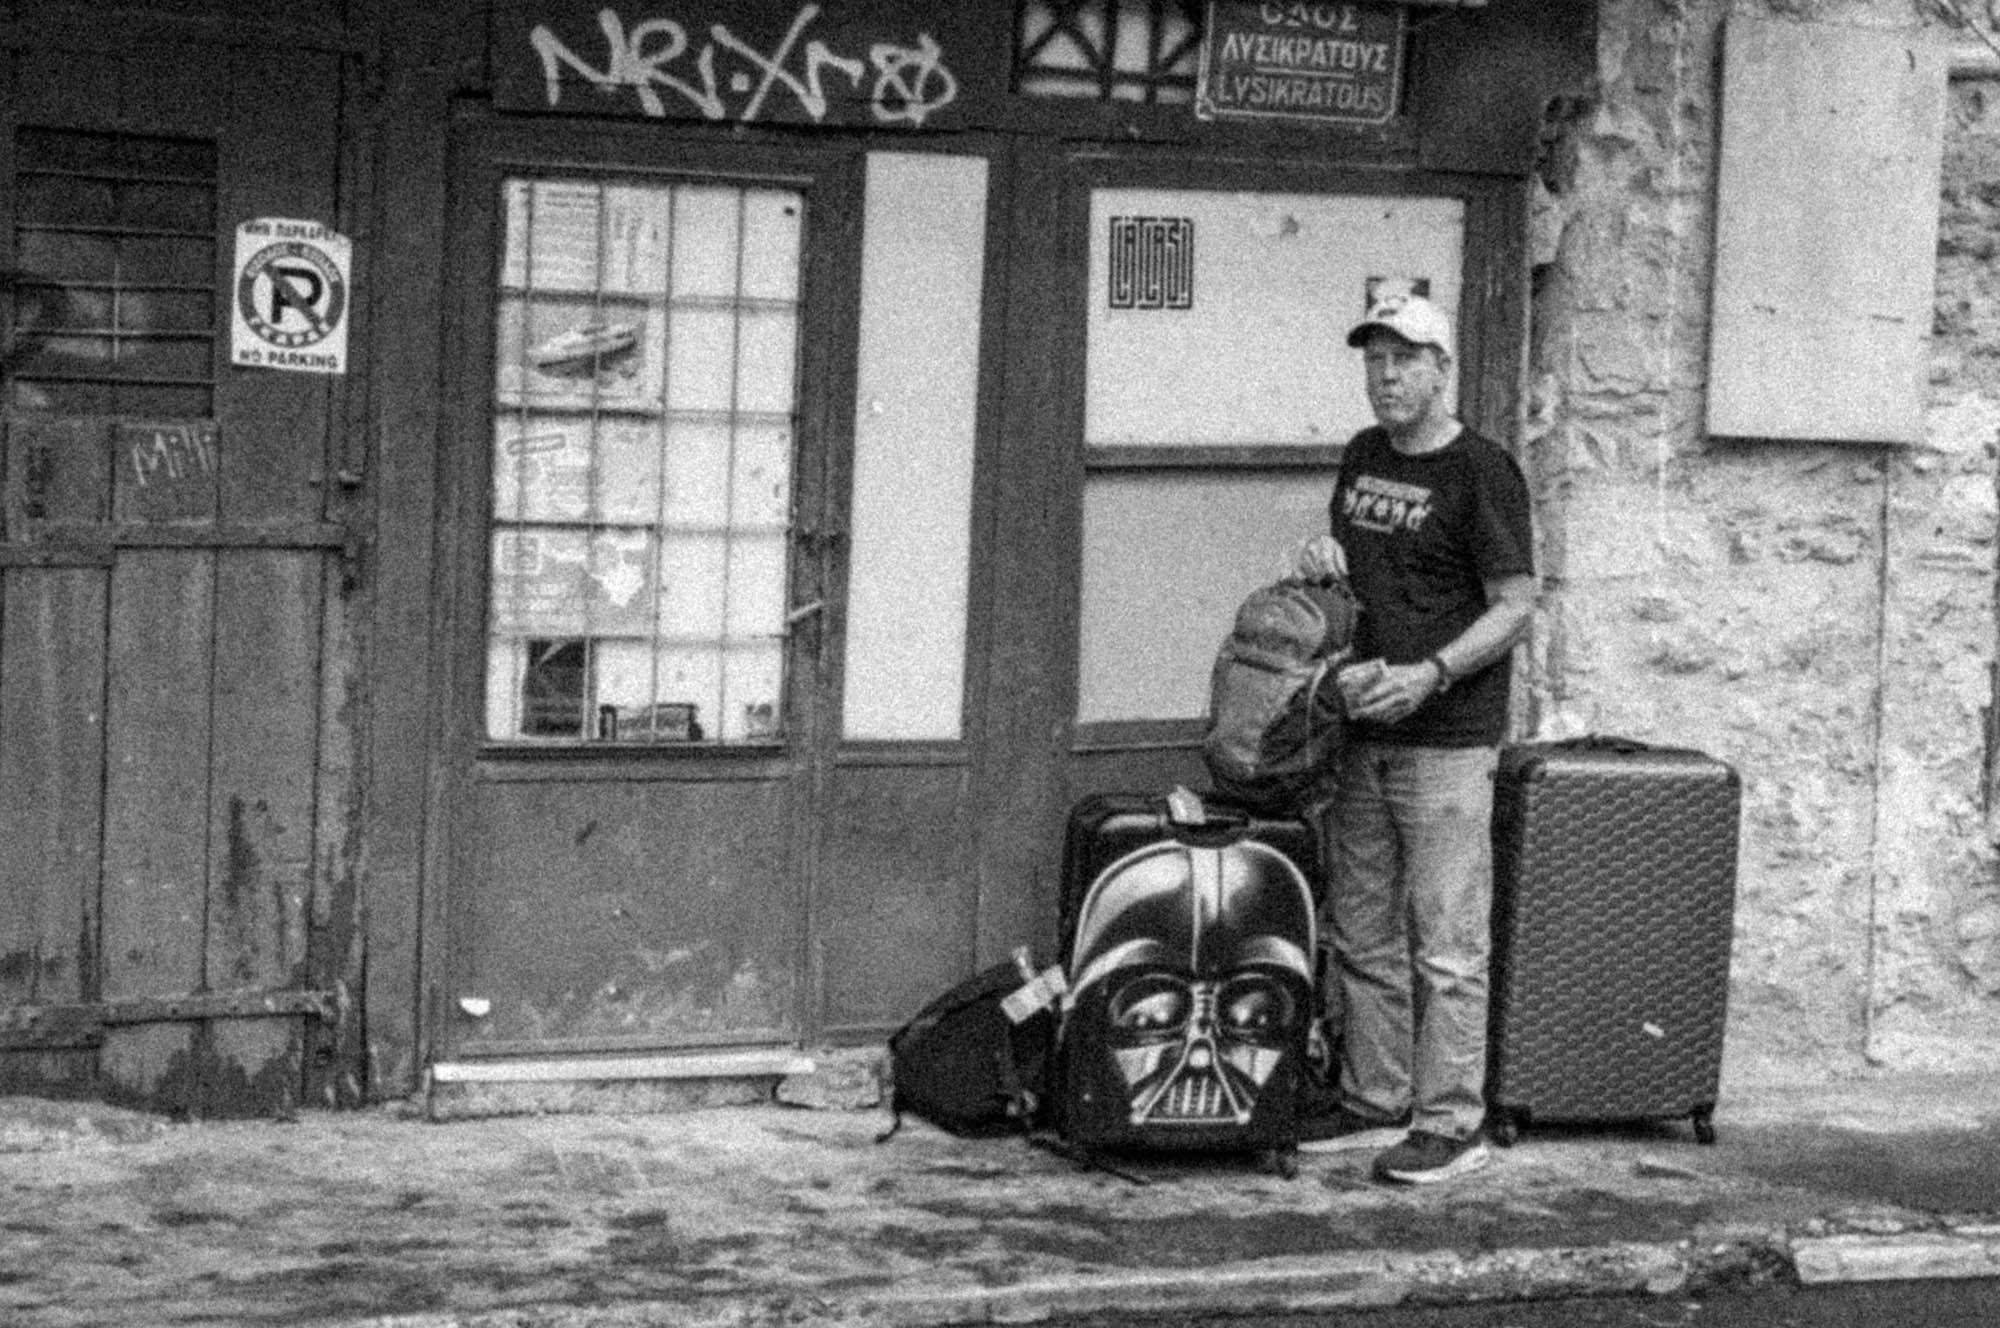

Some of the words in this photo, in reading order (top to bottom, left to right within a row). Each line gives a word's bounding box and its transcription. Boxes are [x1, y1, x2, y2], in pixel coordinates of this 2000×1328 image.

[1222, 33, 1389, 71] ΛΥΣΙΚΡΑΤΟΥΣ
[1218, 74, 1384, 112] LYSIKRATOUS
[240, 350, 262, 364] NO
[268, 351, 338, 369] PARKING
